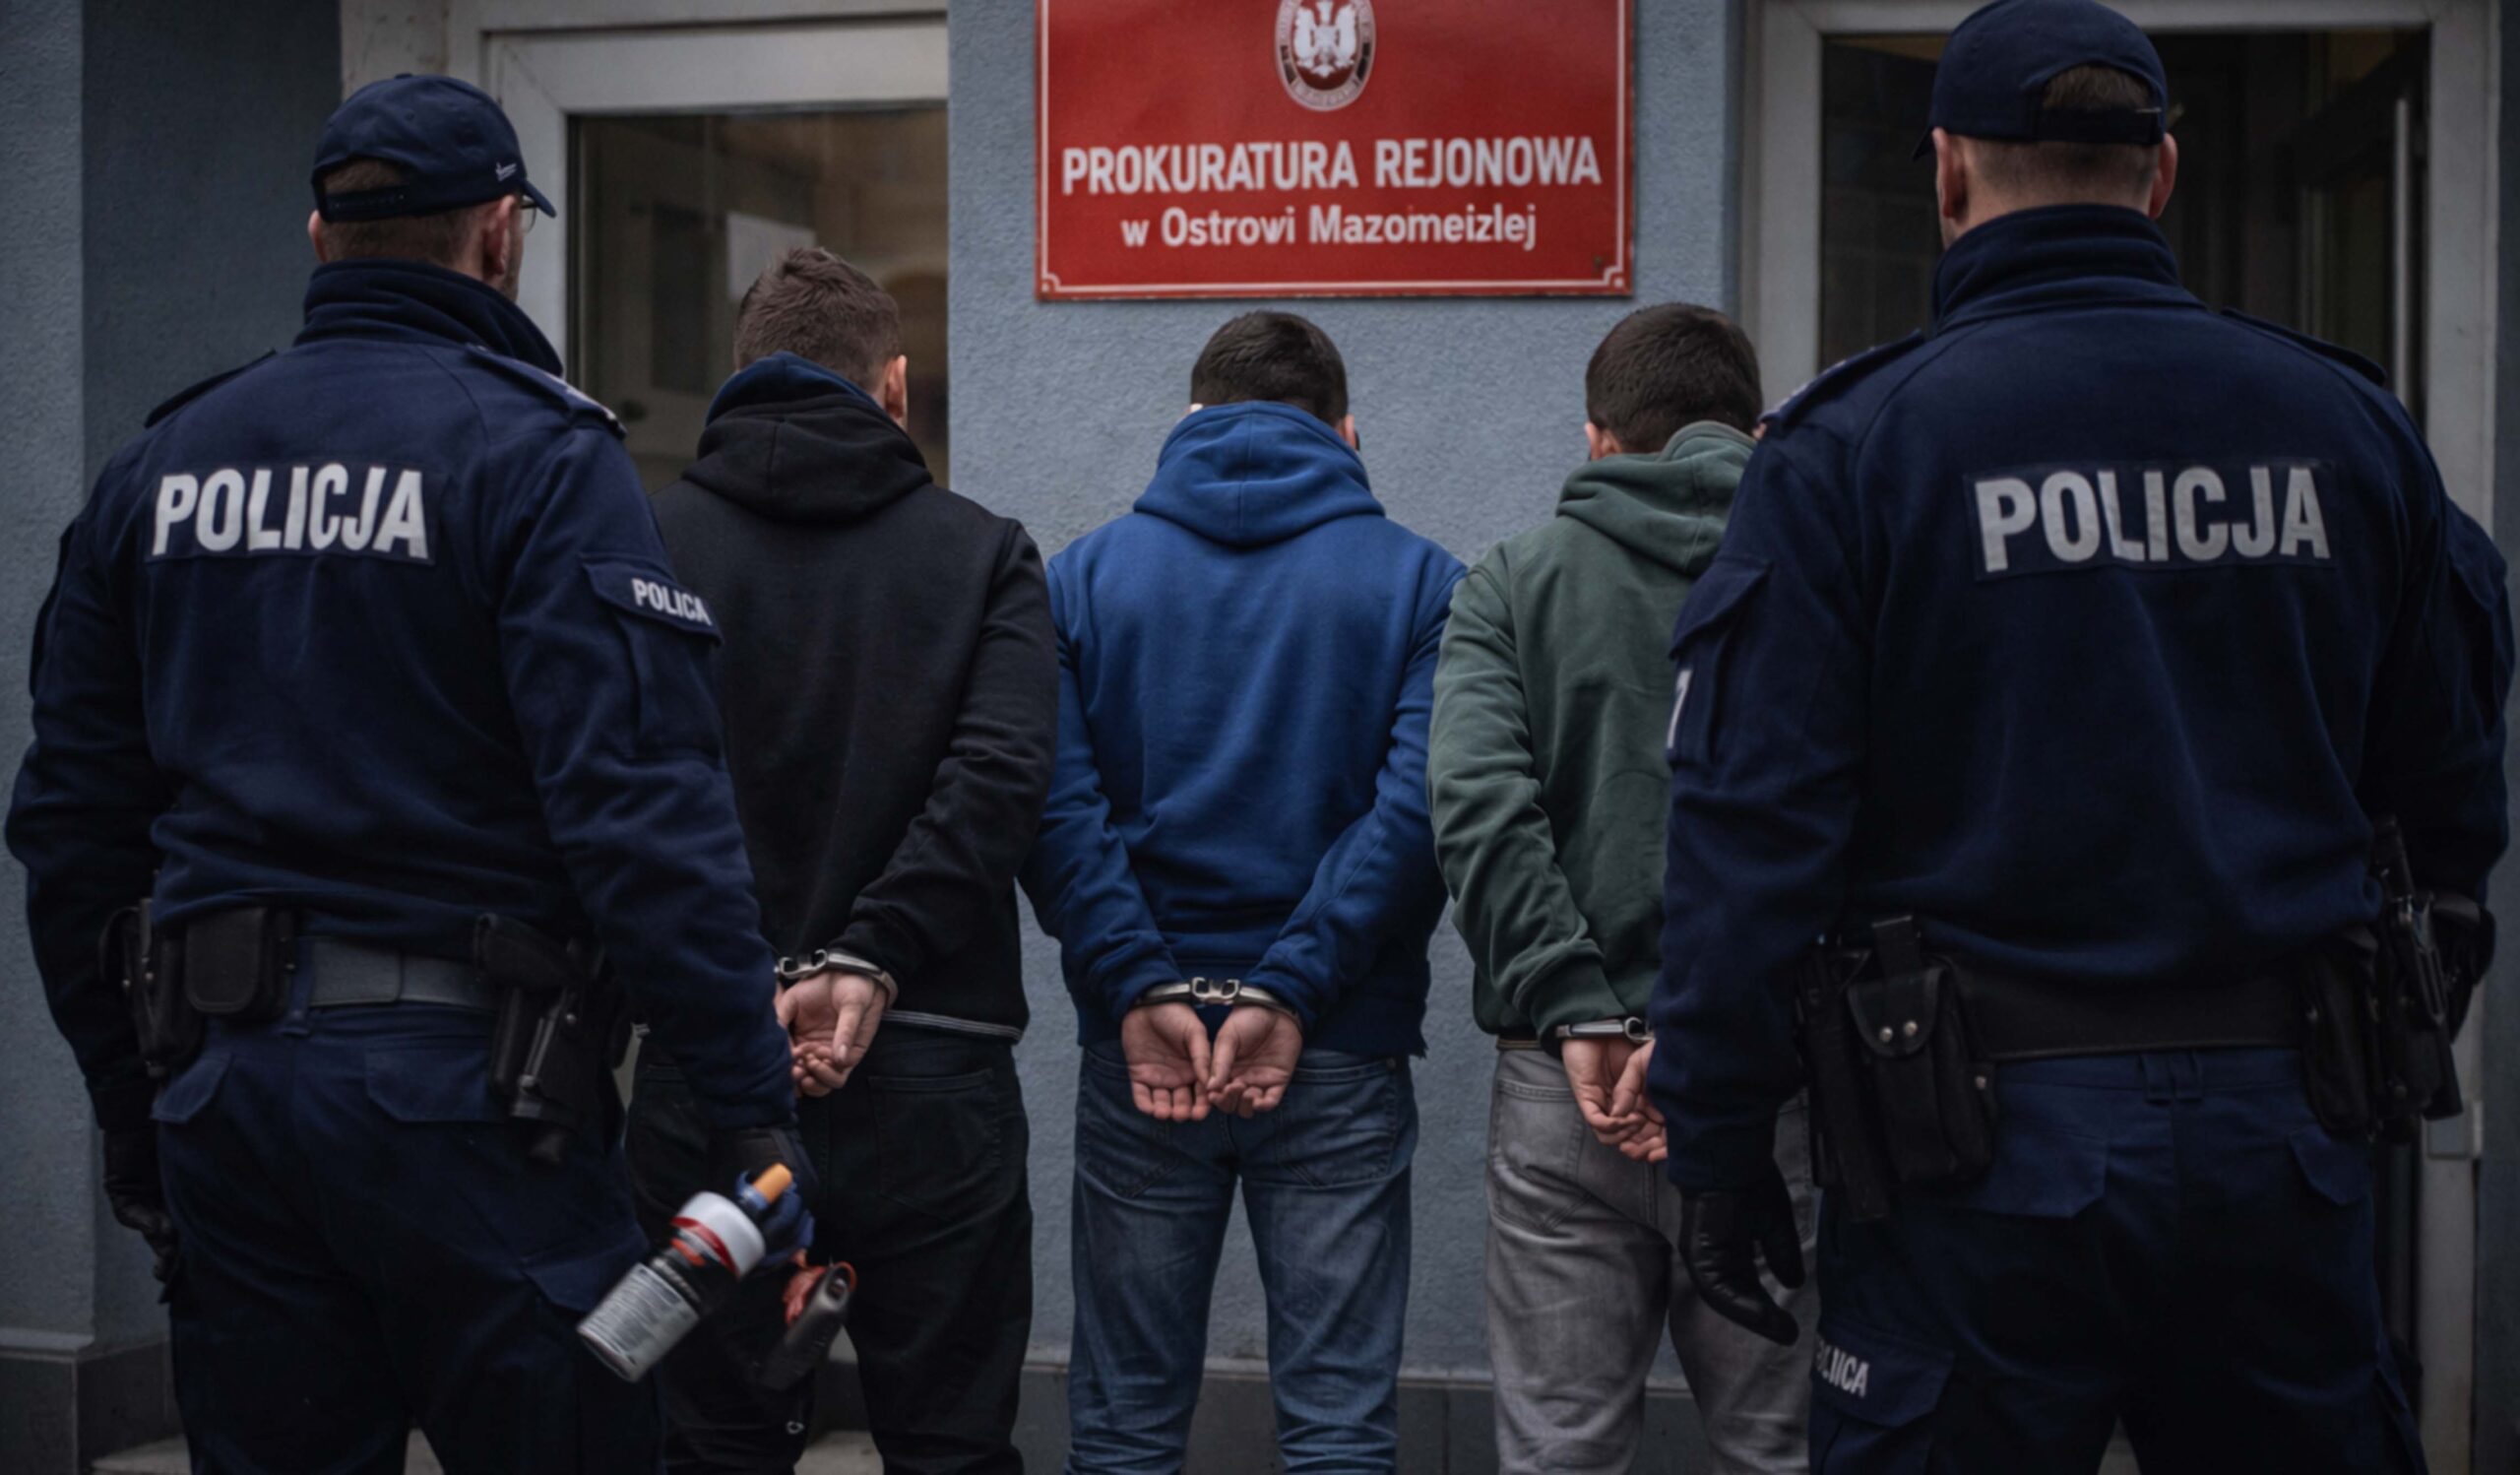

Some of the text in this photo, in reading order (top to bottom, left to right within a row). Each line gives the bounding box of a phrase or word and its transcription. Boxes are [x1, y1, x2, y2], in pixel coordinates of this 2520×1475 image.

[1062, 136, 1601, 195] PROKURATURA REJONOWA
[1120, 219, 1150, 247] w
[1161, 206, 1295, 247] Ostrowi
[153, 463, 428, 559] POLICJA
[1975, 467, 2330, 572] POLICJA
